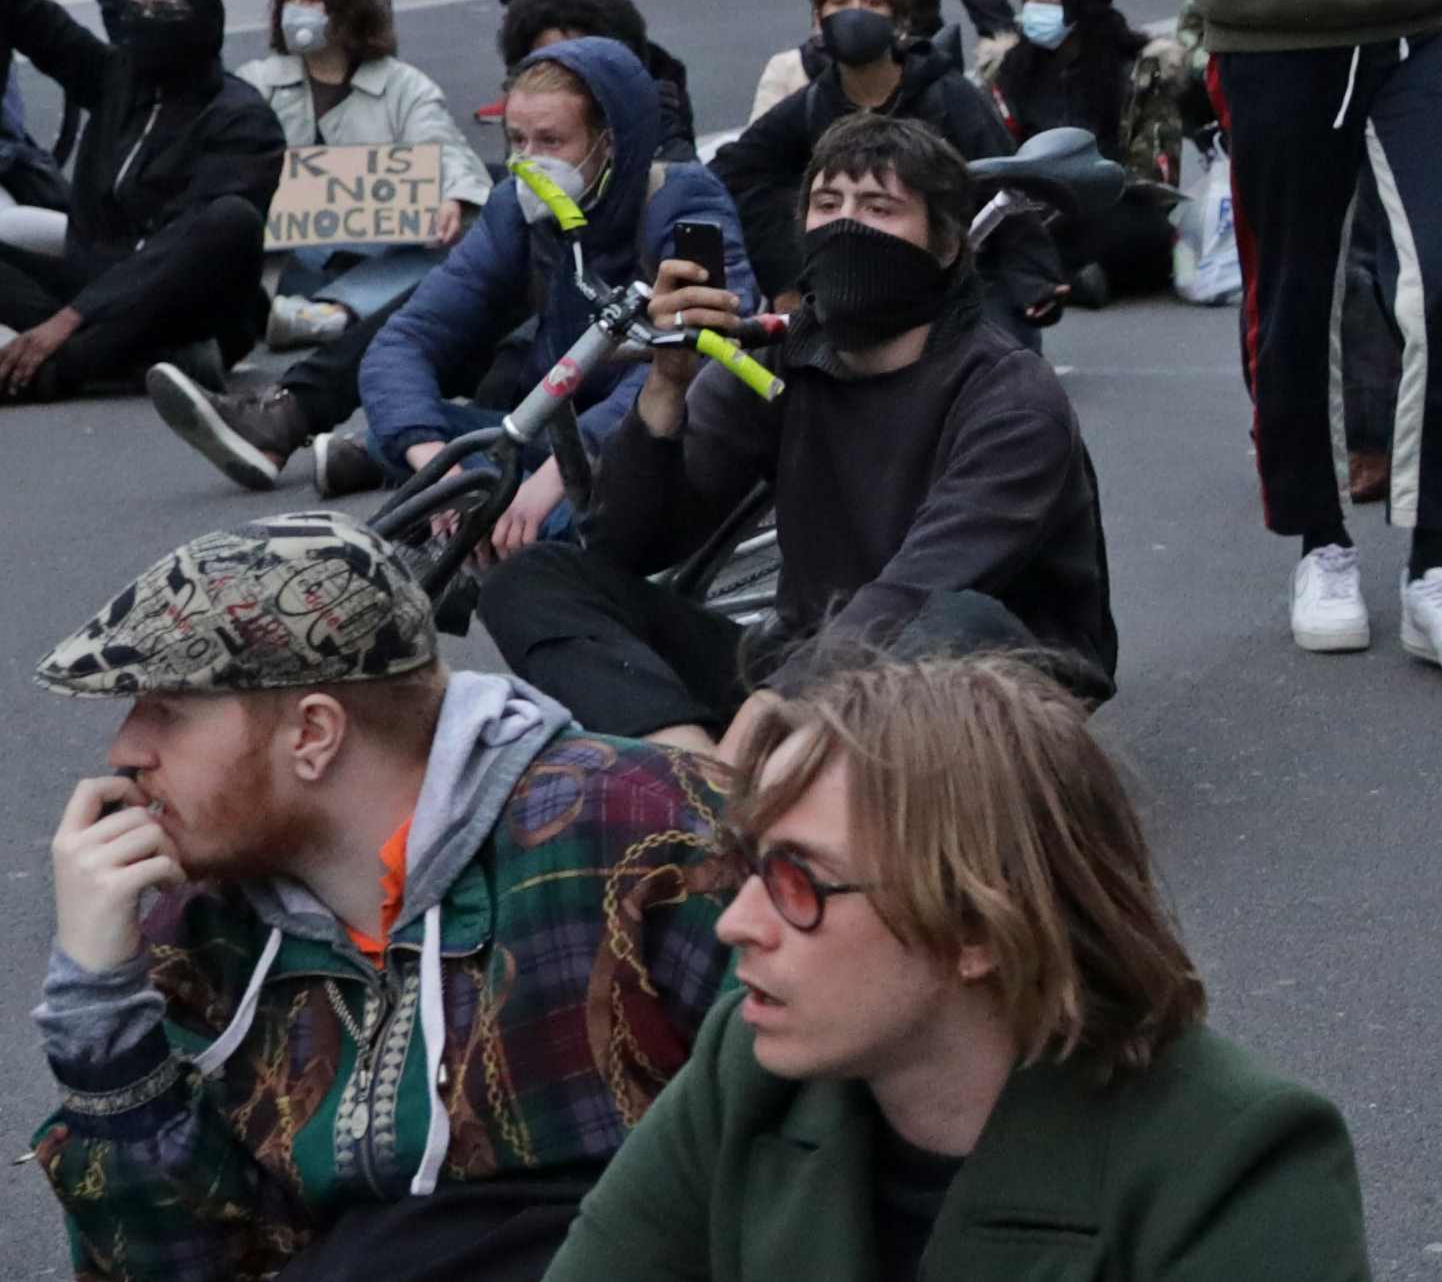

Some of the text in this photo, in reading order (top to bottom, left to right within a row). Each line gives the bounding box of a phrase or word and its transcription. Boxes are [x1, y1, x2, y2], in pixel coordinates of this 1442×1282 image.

[367, 145, 413, 175] IS
[325, 176, 435, 205] NOT
[264, 206, 439, 241] NNOCENT
